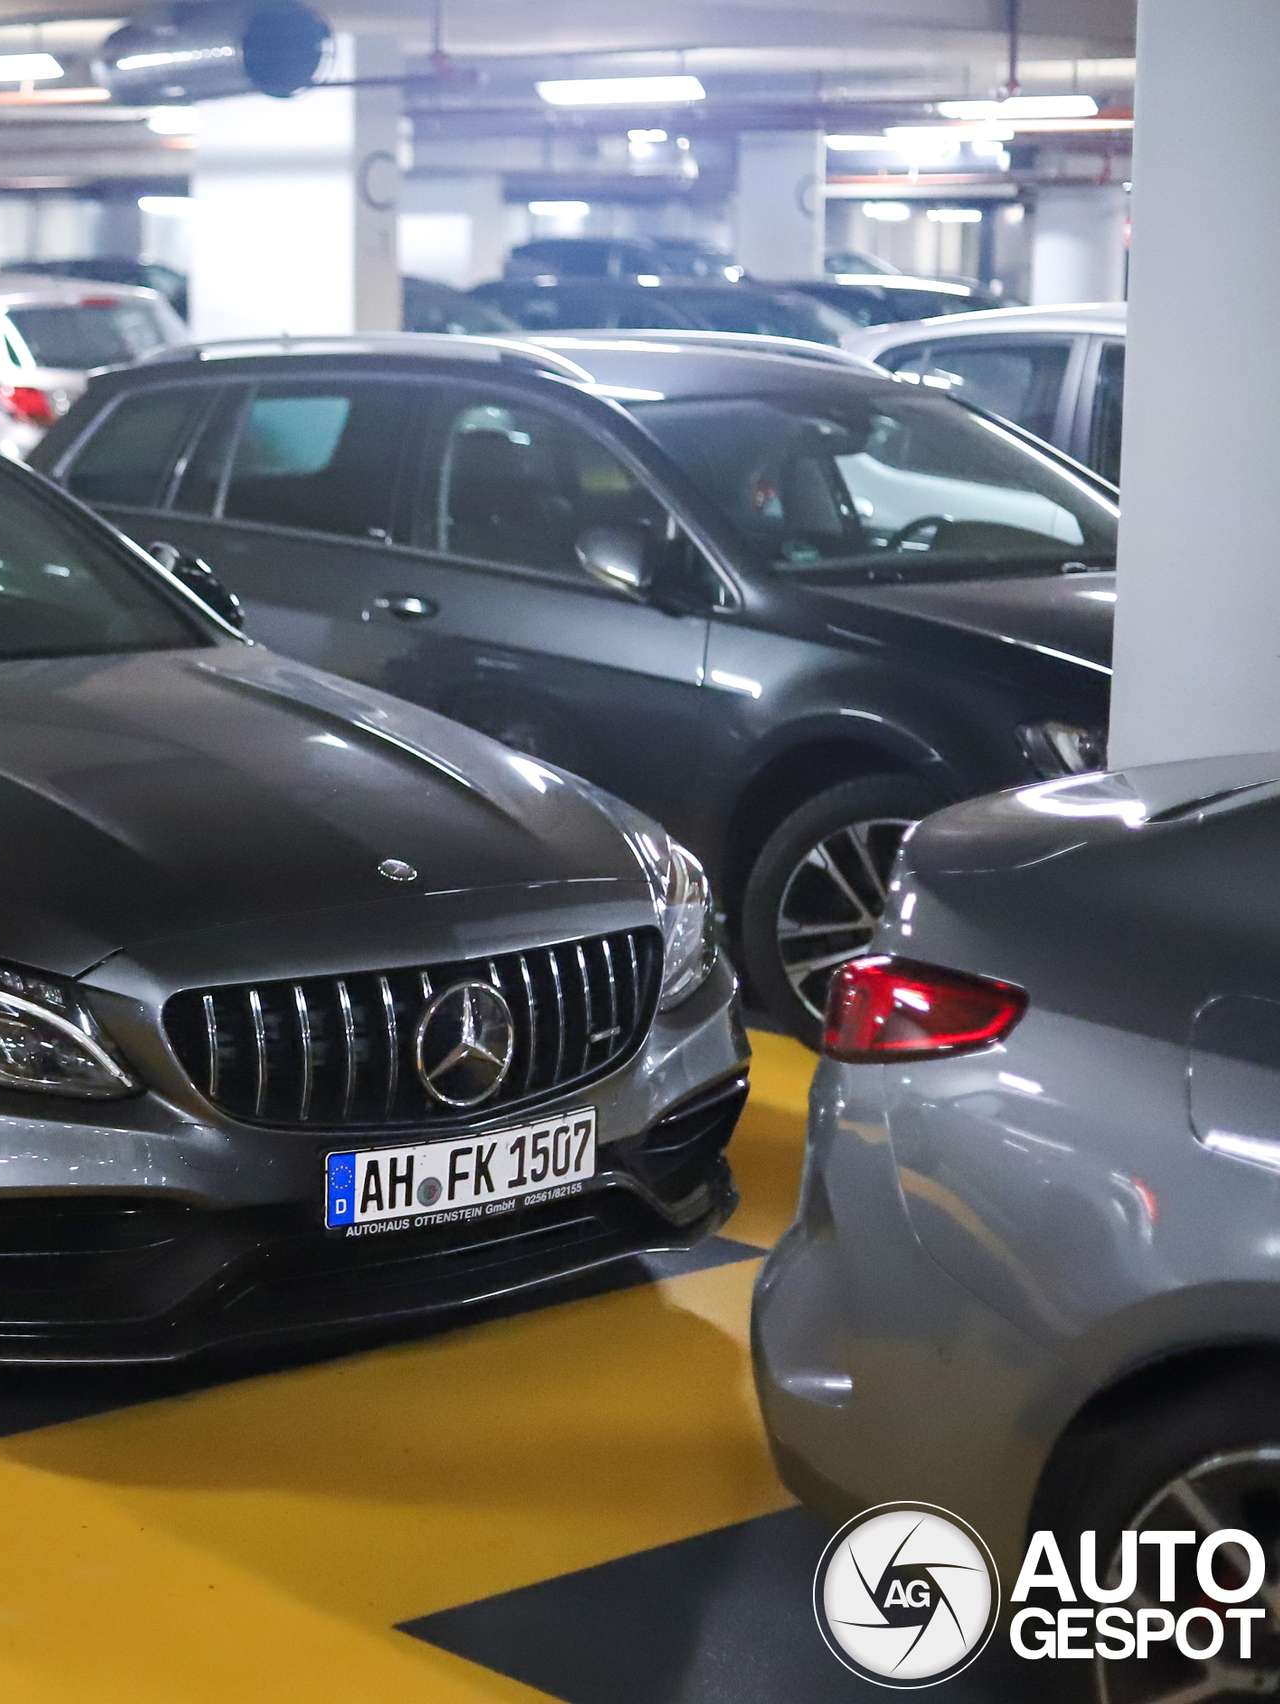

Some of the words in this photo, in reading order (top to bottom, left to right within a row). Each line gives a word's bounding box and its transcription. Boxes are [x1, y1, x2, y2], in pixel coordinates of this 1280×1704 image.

[360, 1154, 414, 1213] AH
[447, 1142, 497, 1201] FK
[508, 1120, 592, 1188] 1507
[335, 1198, 347, 1215] D
[346, 1218, 410, 1237] AUTOHAUS
[414, 1206, 482, 1228] OTTENSTEIN
[485, 1199, 516, 1215] GmbH
[524, 1182, 582, 1206] 02561/82155
